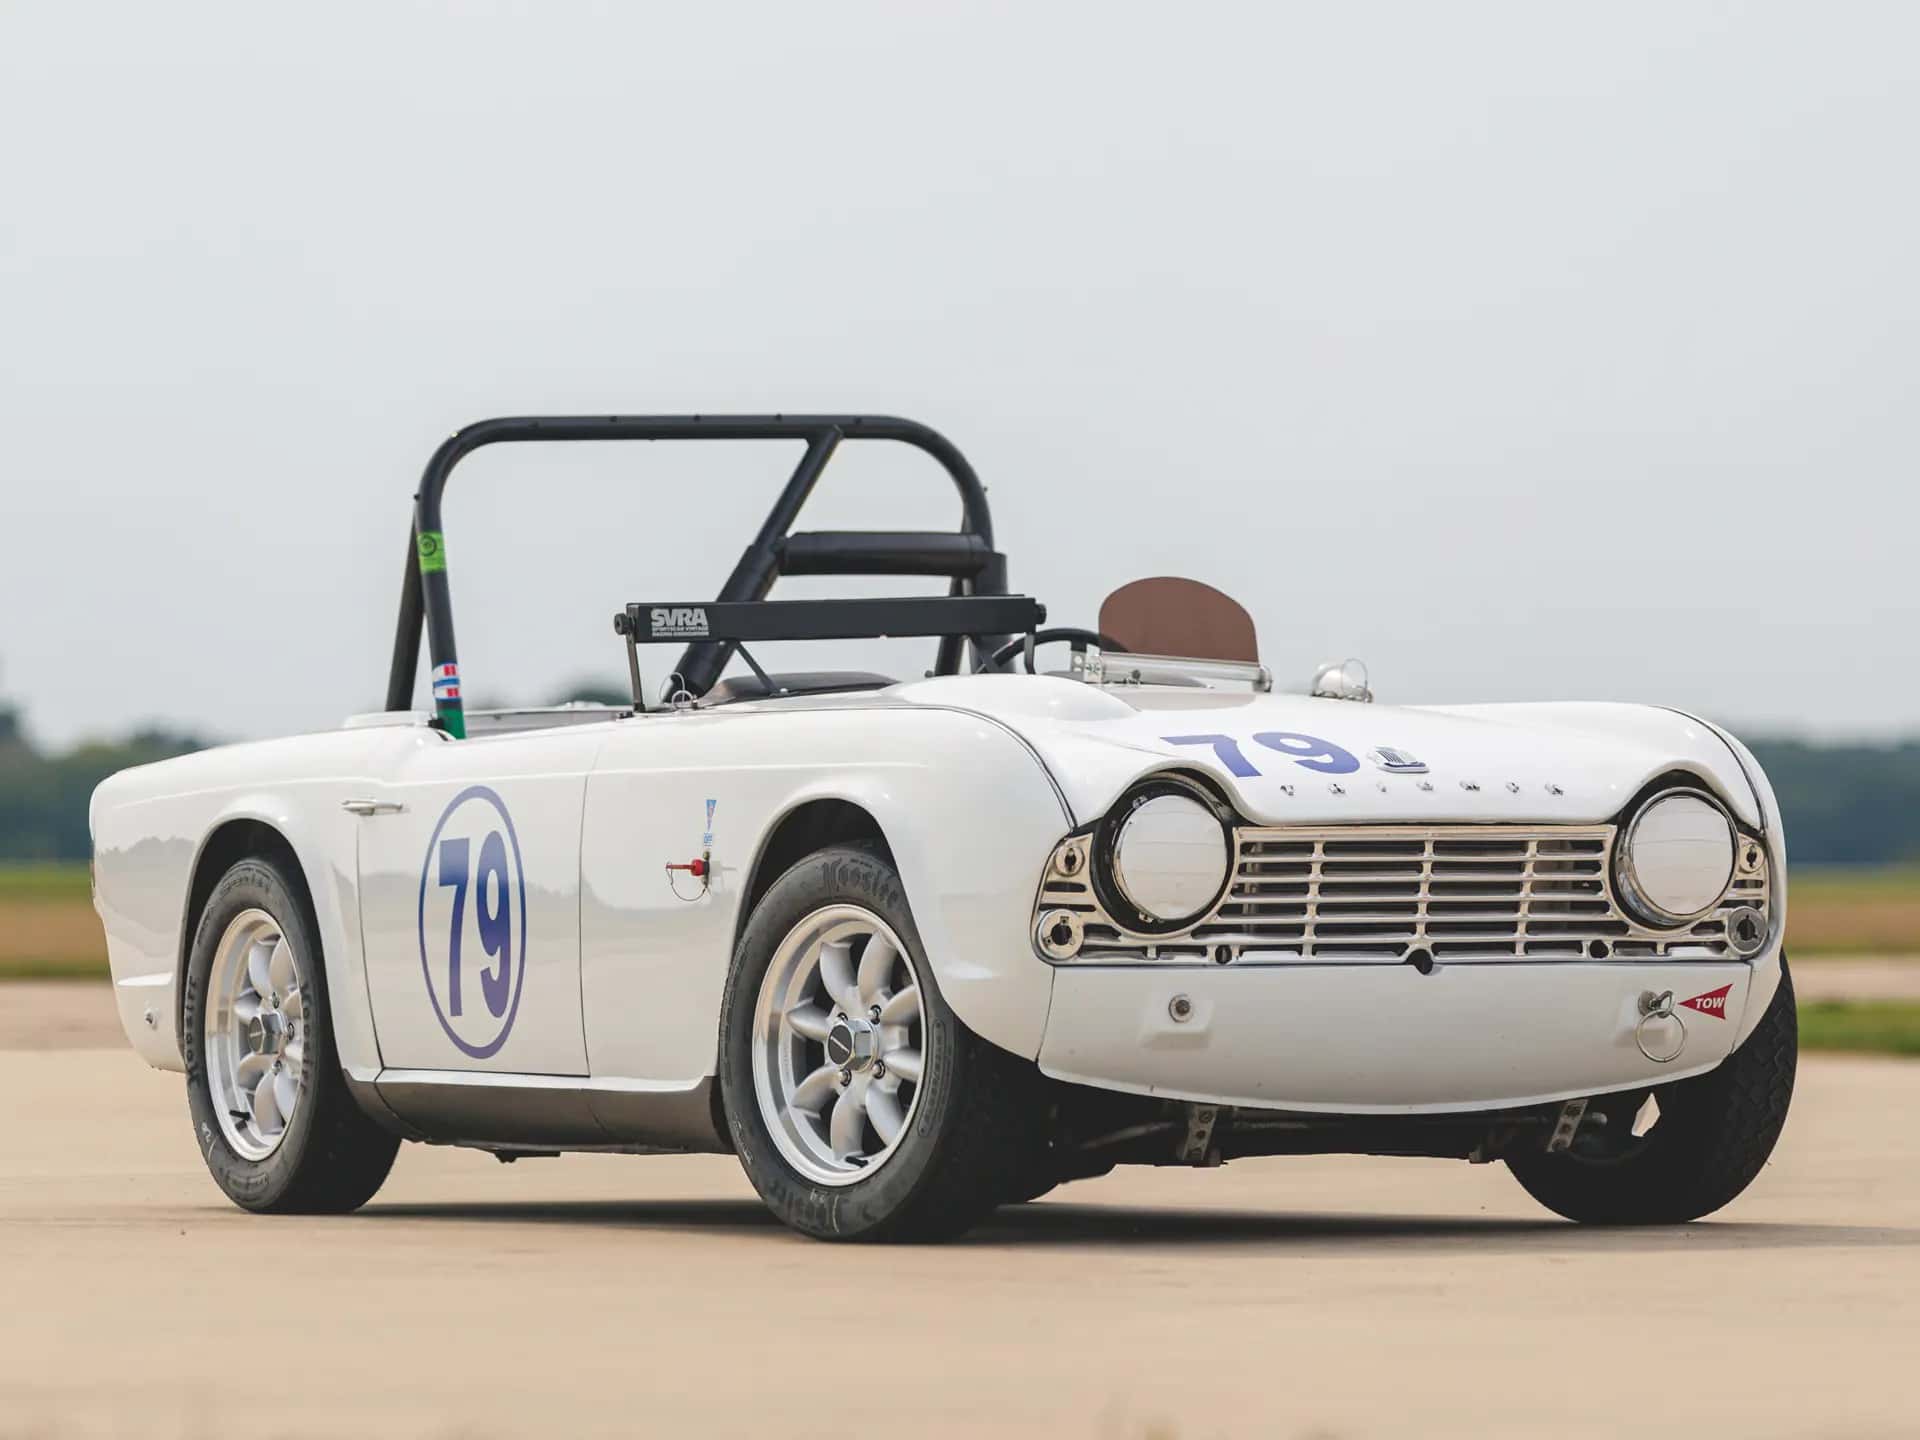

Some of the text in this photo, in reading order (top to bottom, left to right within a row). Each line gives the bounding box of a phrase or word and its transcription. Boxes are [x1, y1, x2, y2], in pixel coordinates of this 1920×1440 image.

[651, 608, 708, 627] SVRA
[1160, 731, 1360, 778] 79
[438, 830, 511, 1018] 79
[1695, 997, 1725, 1009] TOW
